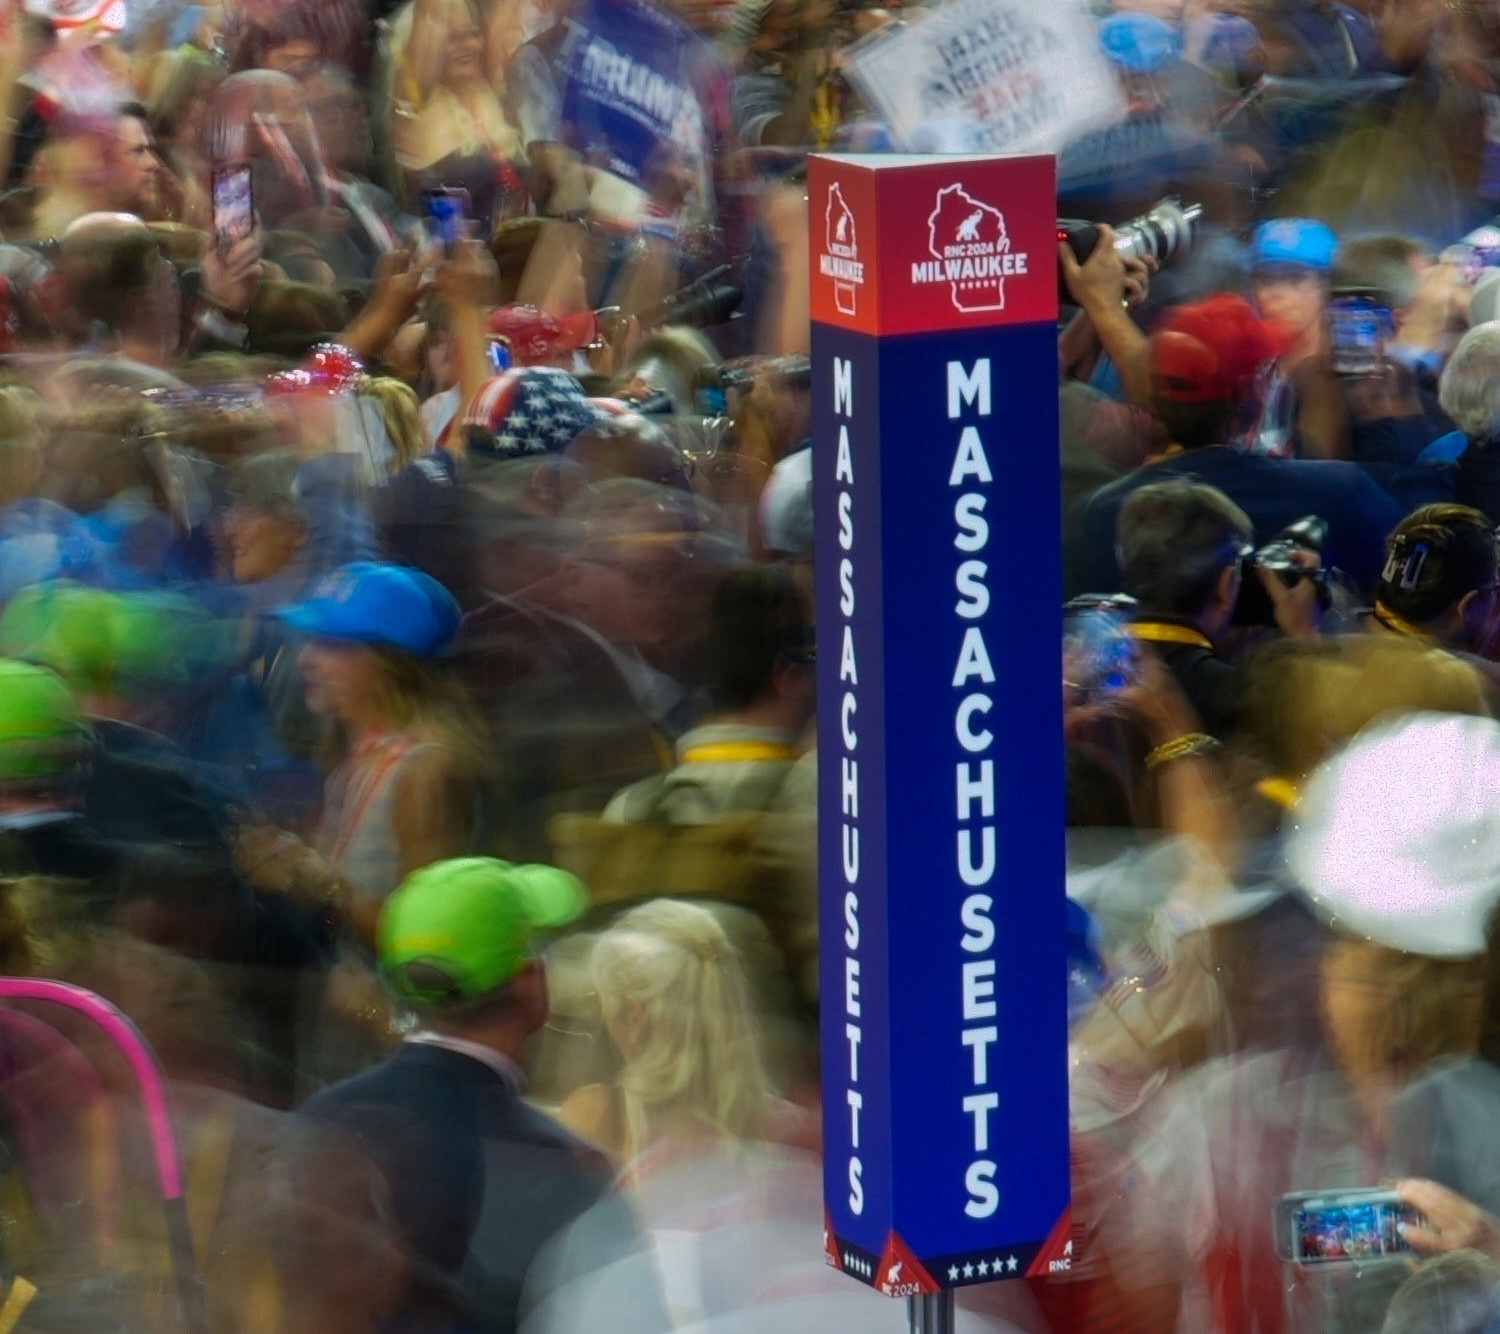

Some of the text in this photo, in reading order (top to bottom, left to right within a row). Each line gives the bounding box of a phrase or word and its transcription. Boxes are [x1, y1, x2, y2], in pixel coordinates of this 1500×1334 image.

[944, 242, 994, 258] RNC 2024
[911, 253, 1027, 284] MILWAUKEE
[832, 355, 865, 1218] MASSACHUSETTS
[946, 357, 1000, 1221] MASSACHUSETTS
[1049, 1258, 1071, 1273] RNC
[894, 1282, 920, 1297] 2024
